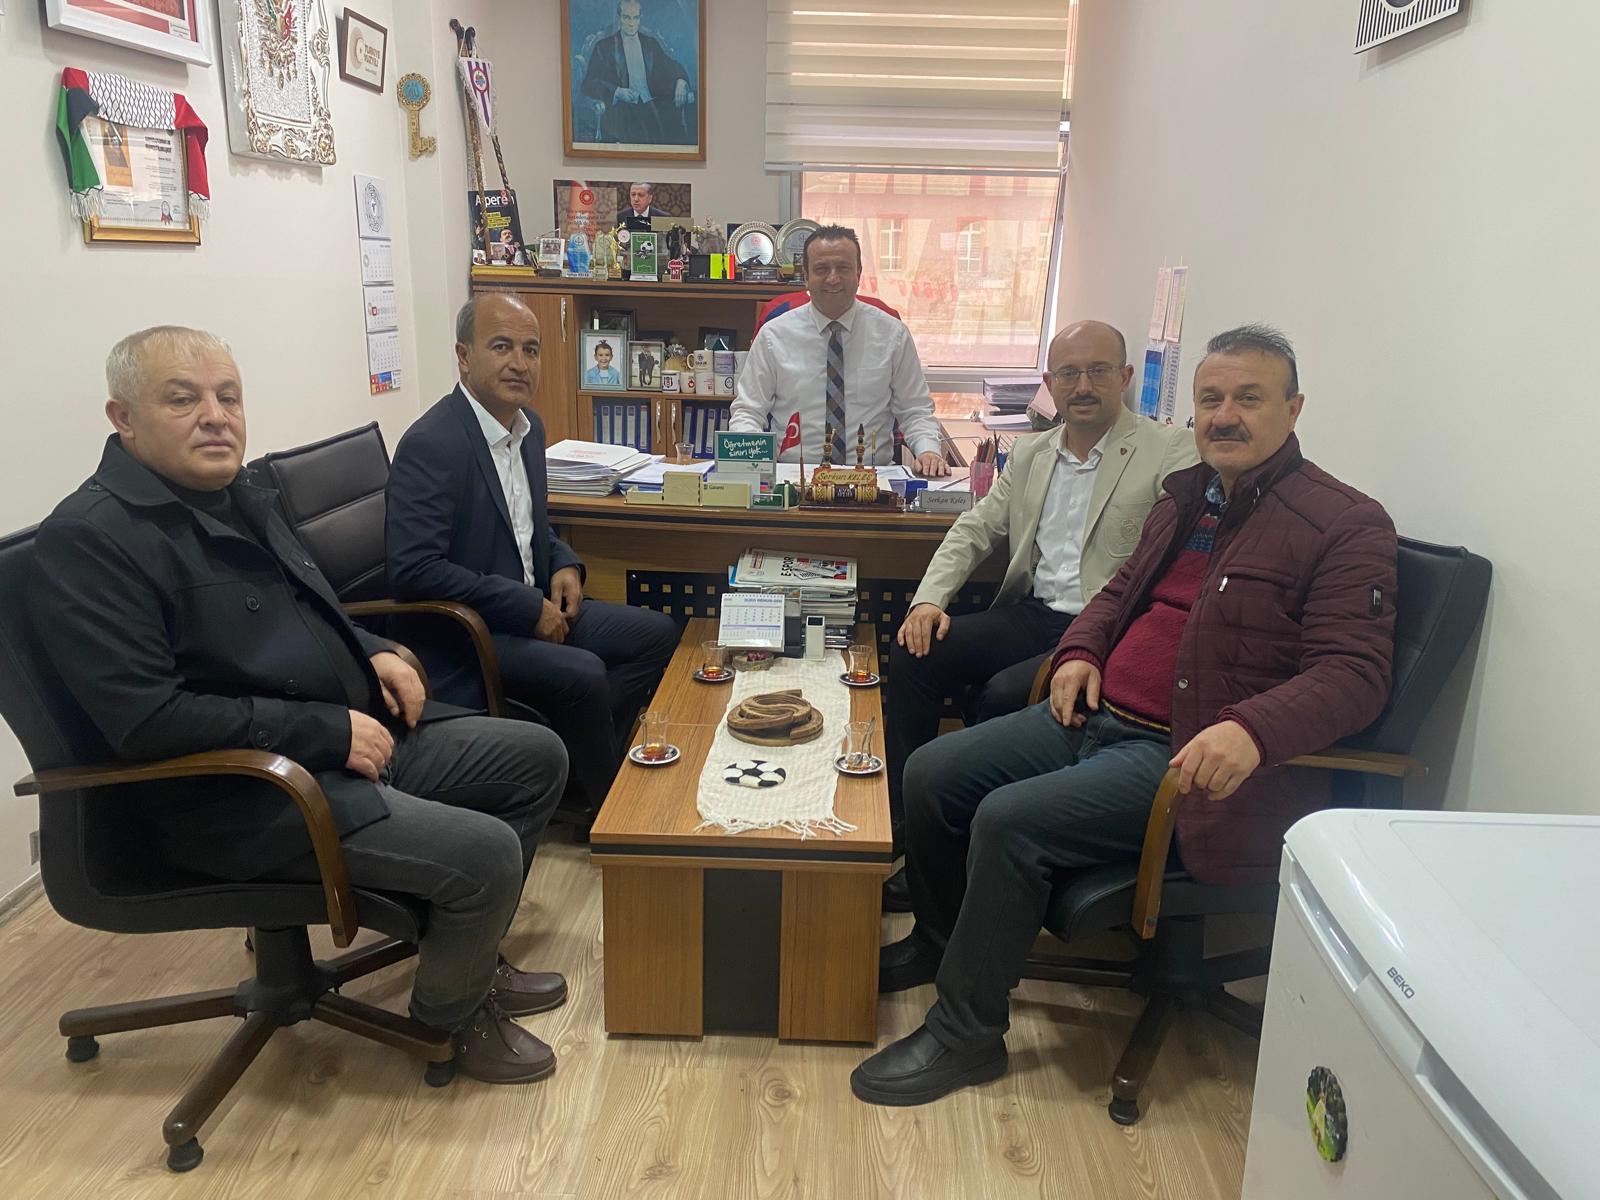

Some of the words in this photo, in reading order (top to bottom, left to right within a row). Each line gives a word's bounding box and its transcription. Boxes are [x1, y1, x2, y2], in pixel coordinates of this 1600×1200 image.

[723, 438, 767, 451] Öğretmenin
[927, 496, 949, 504] Serkan
[1387, 966, 1415, 999] BEKO
